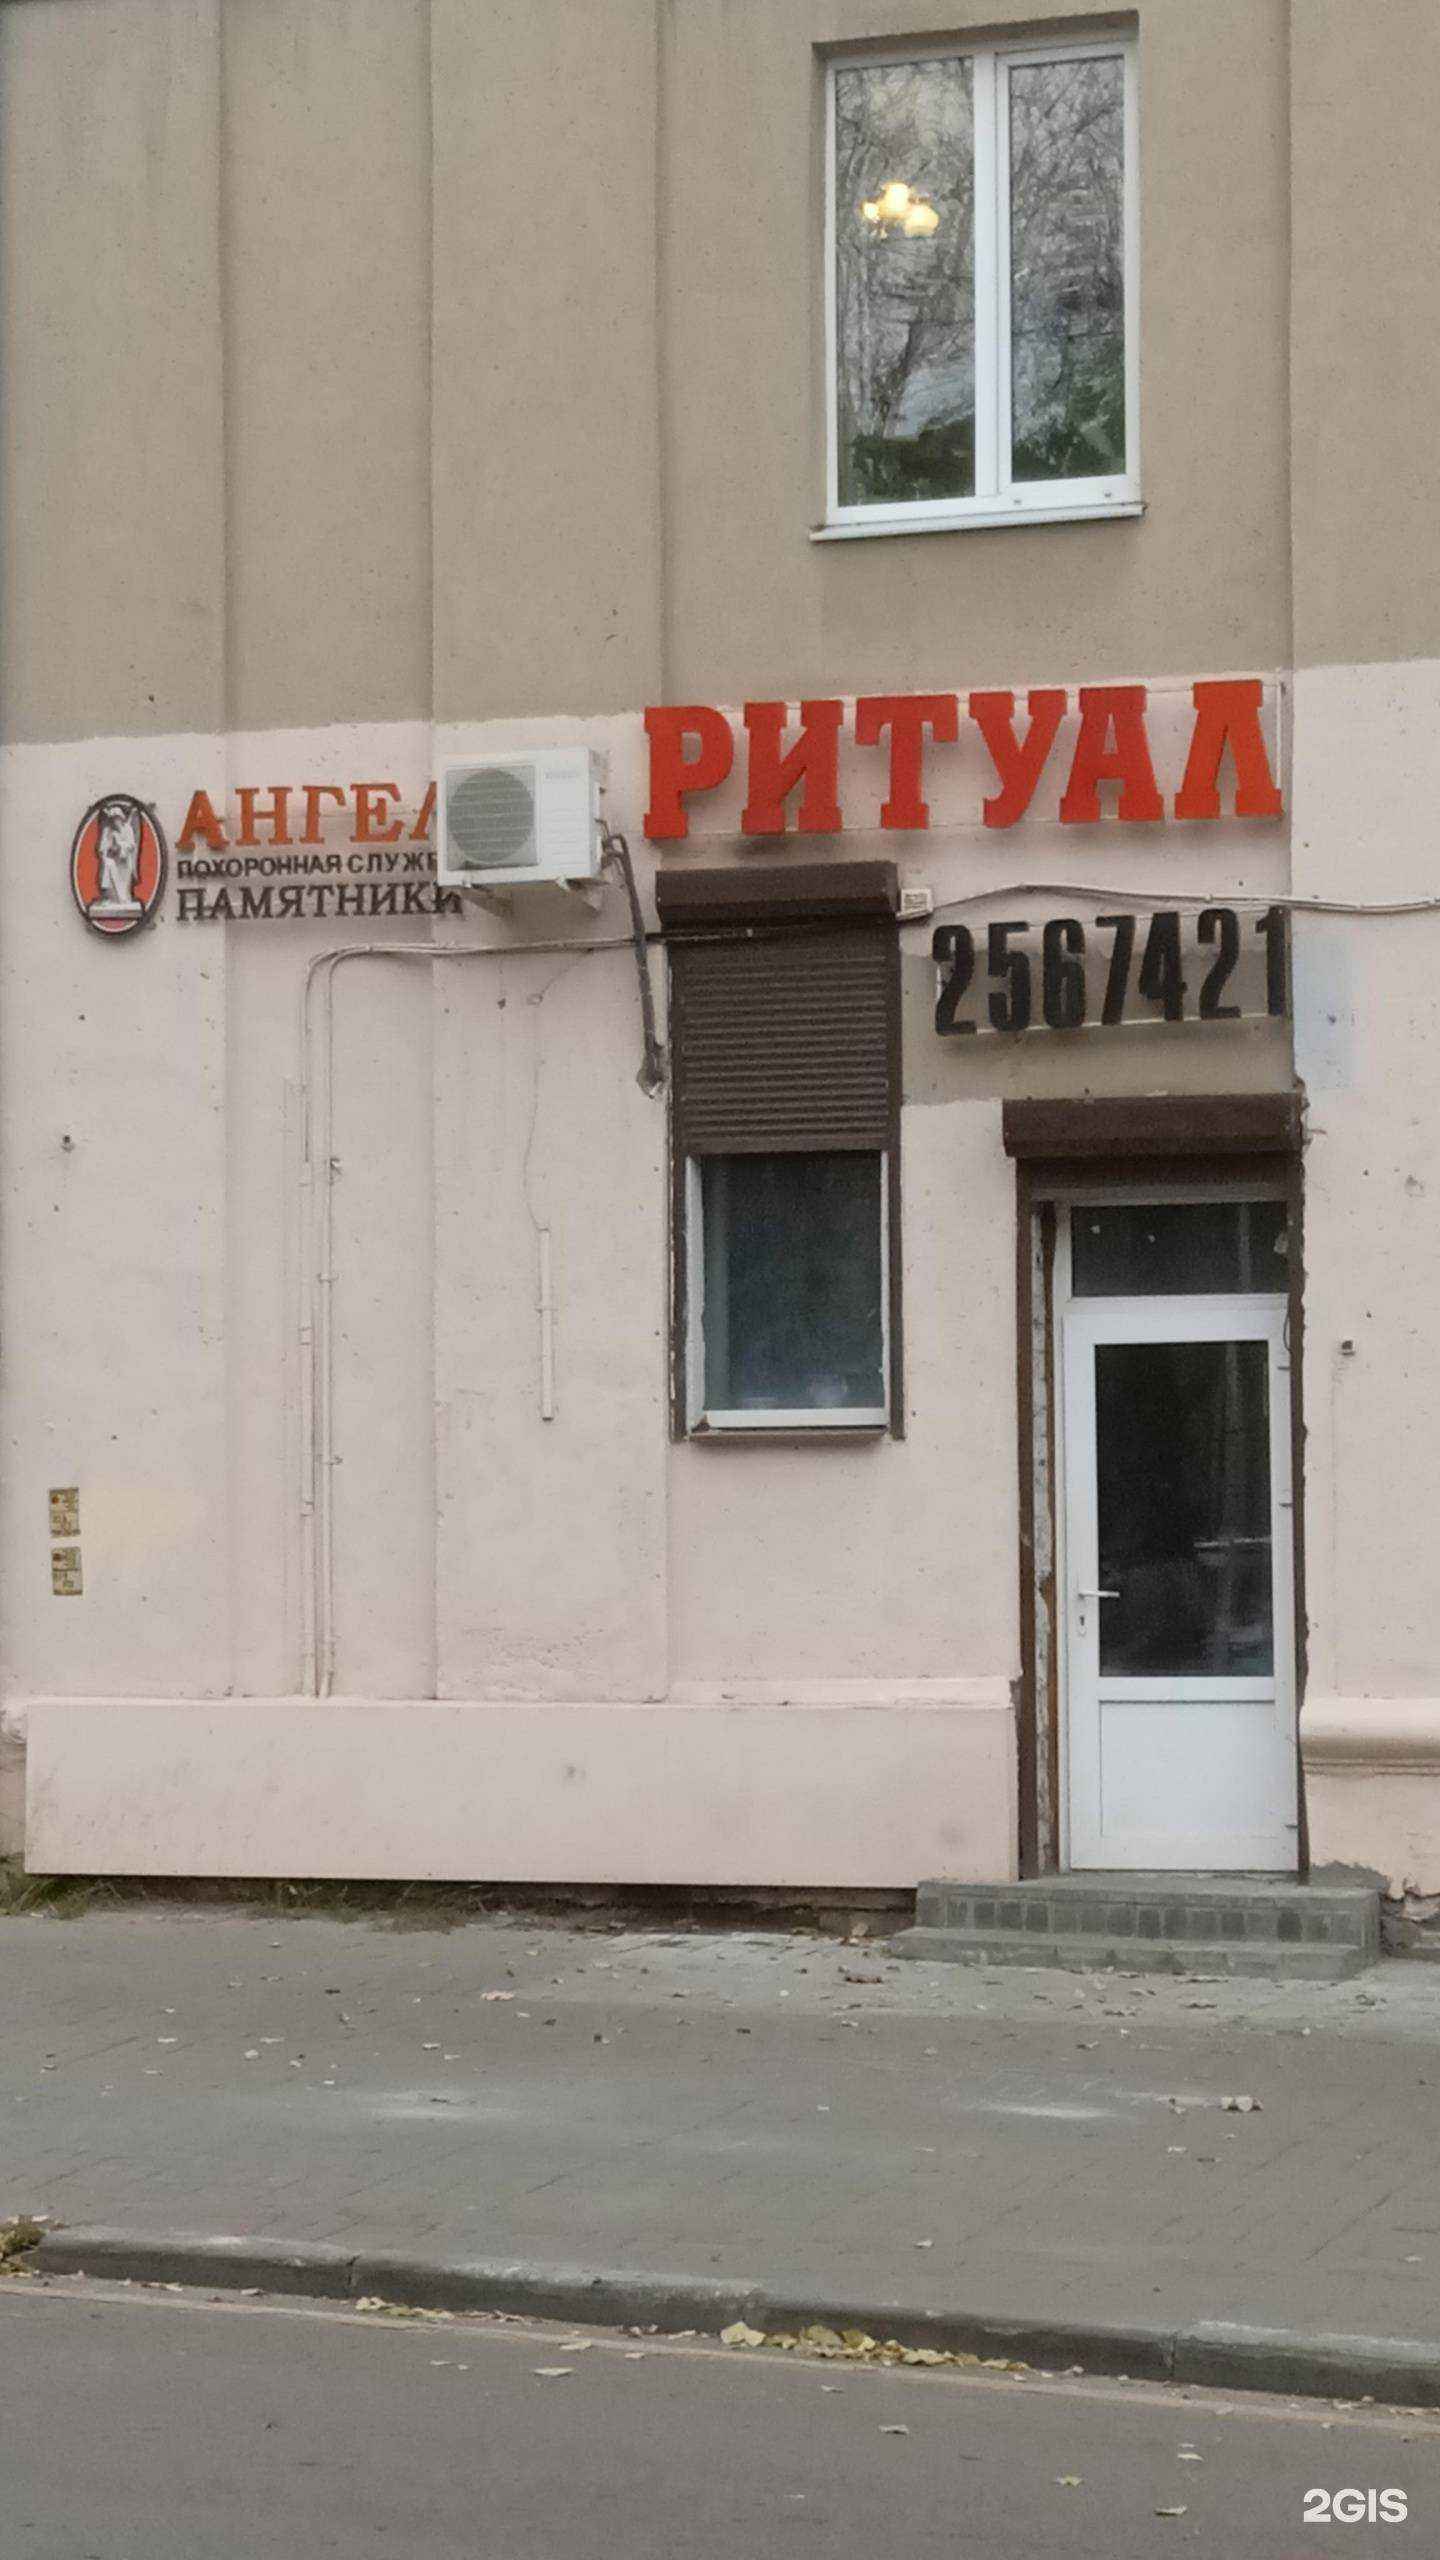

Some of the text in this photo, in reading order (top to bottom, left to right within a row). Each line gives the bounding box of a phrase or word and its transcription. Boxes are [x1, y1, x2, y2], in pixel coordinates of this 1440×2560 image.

[643, 679, 1284, 839] РИТУАЛ
[176, 853, 343, 879] ПОХОРОННАЯ
[176, 881, 463, 921] ПАМЯТНИКИ
[931, 905, 1289, 1036] 2567421
